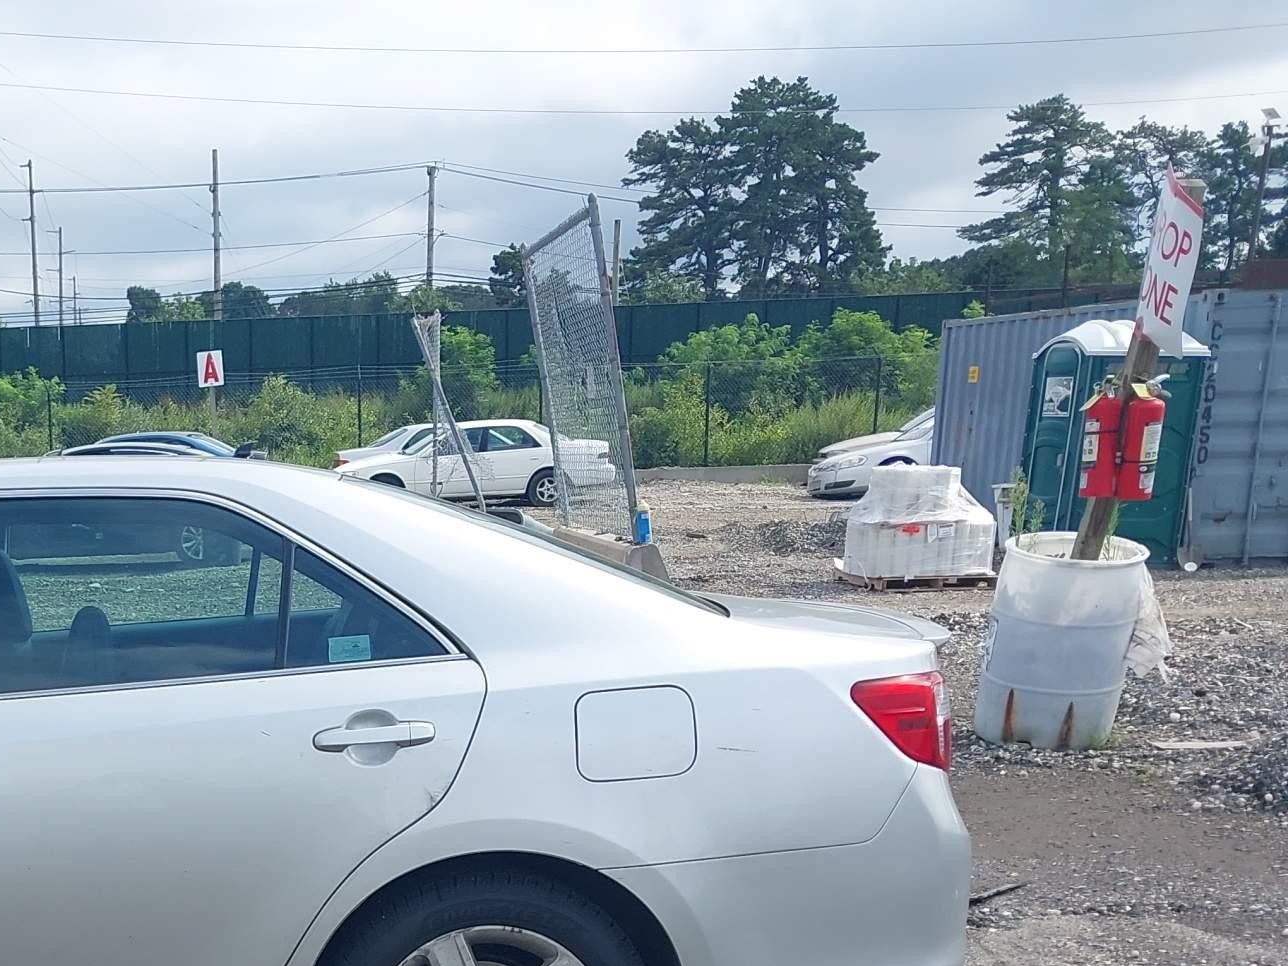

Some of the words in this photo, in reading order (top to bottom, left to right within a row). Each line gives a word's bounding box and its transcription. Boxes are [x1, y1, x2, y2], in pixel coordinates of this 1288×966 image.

[1155, 211, 1193, 268] ROP
[1142, 264, 1178, 326] ONE
[203, 352, 219, 384] A
